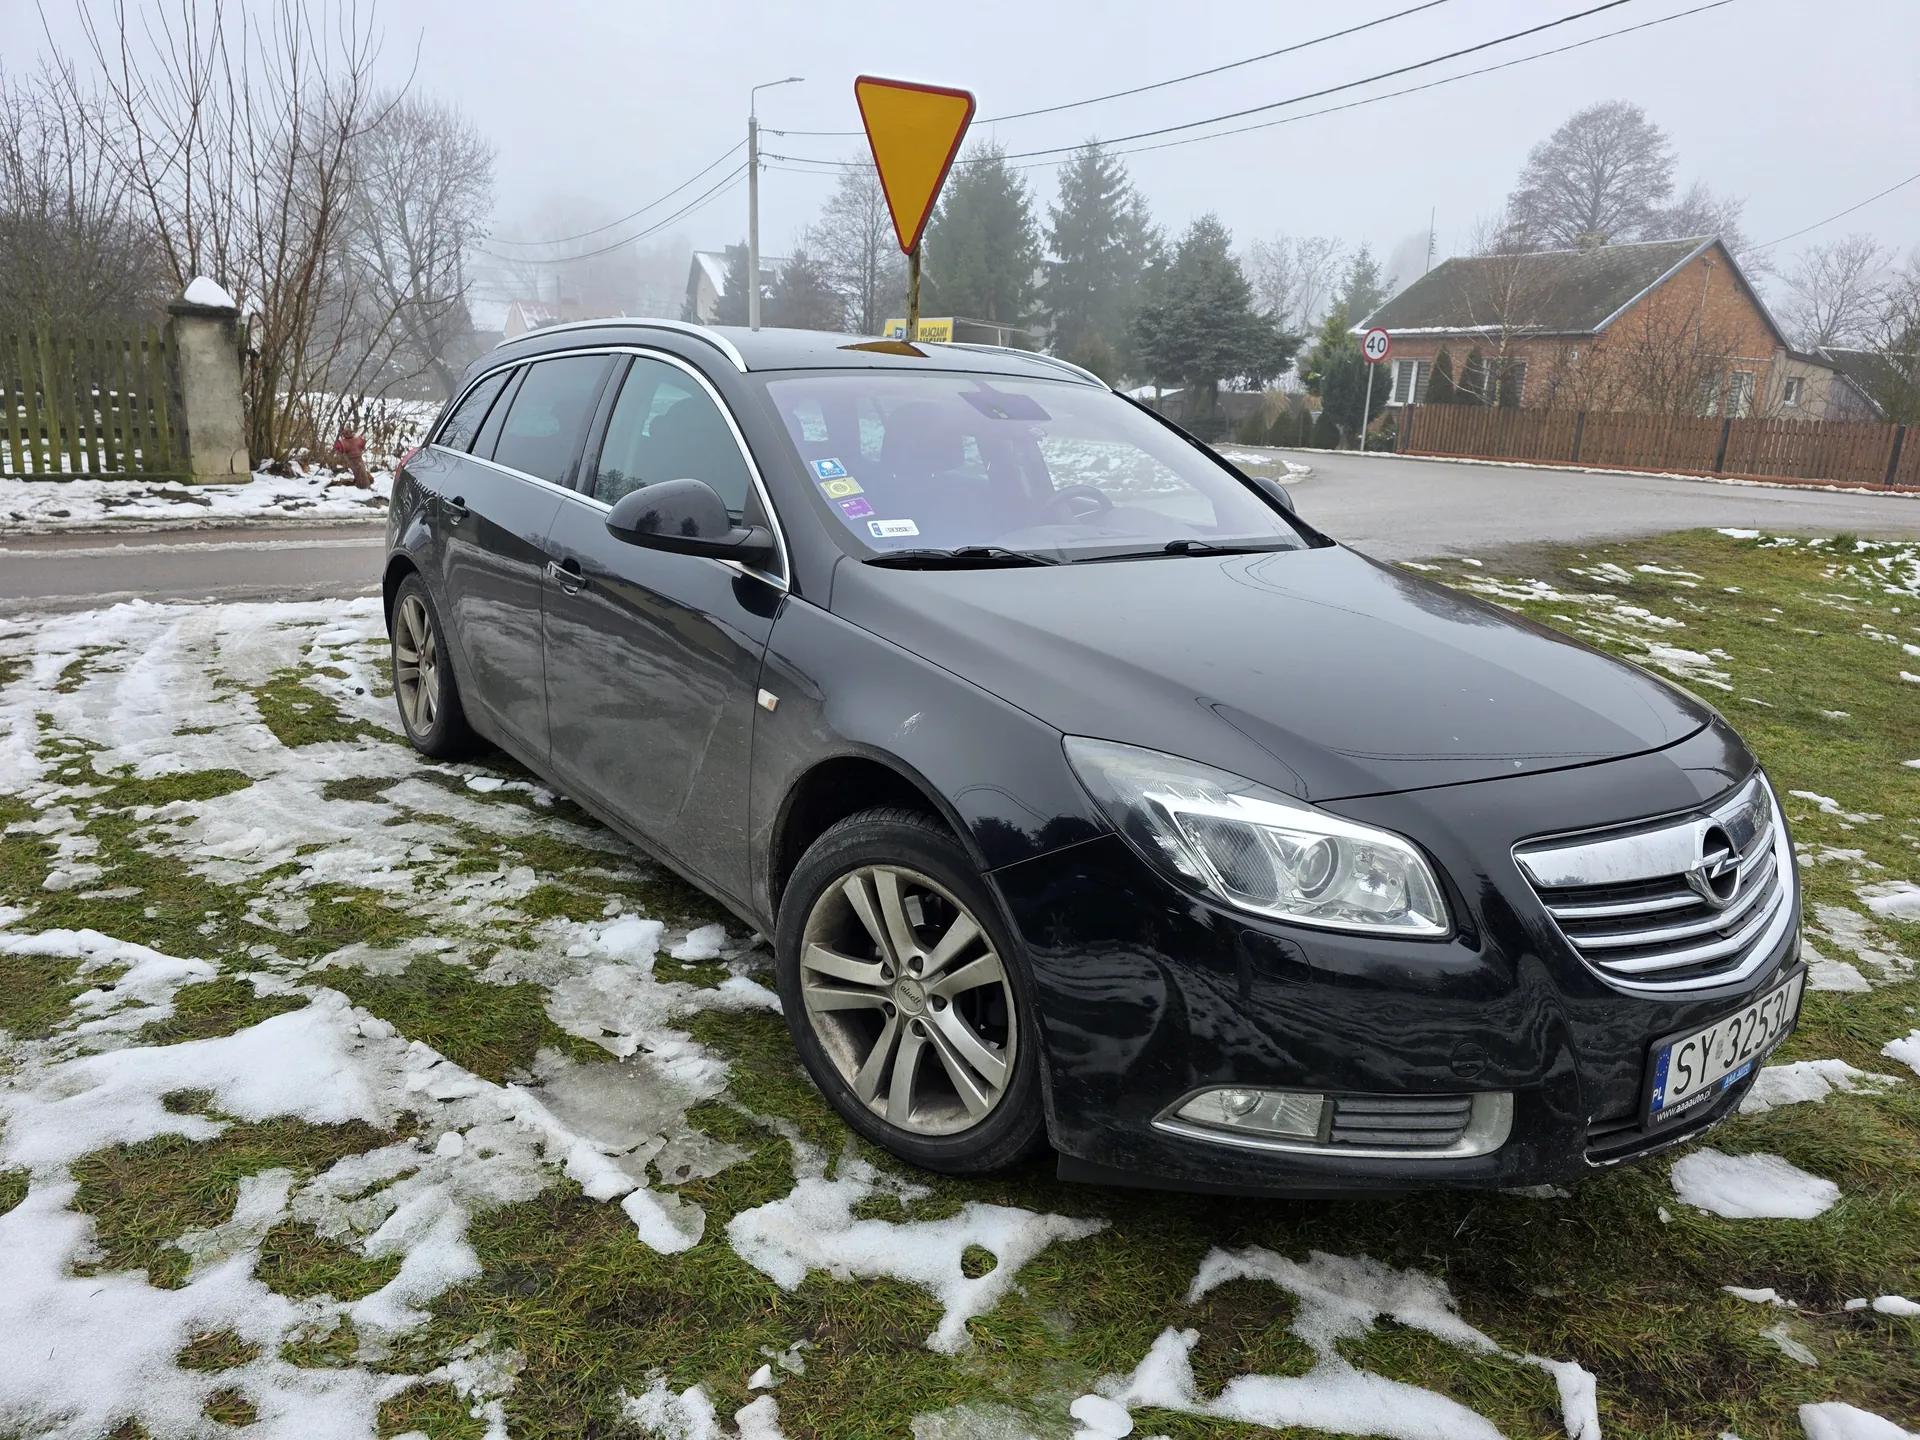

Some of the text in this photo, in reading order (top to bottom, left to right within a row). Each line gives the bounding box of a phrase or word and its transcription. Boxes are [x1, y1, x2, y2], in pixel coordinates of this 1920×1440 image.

[1366, 336, 1387, 353] 40
[1673, 1028, 1718, 1095] SY
[1723, 983, 1790, 1069] 3253L
[1652, 1087, 1663, 1103] PL
